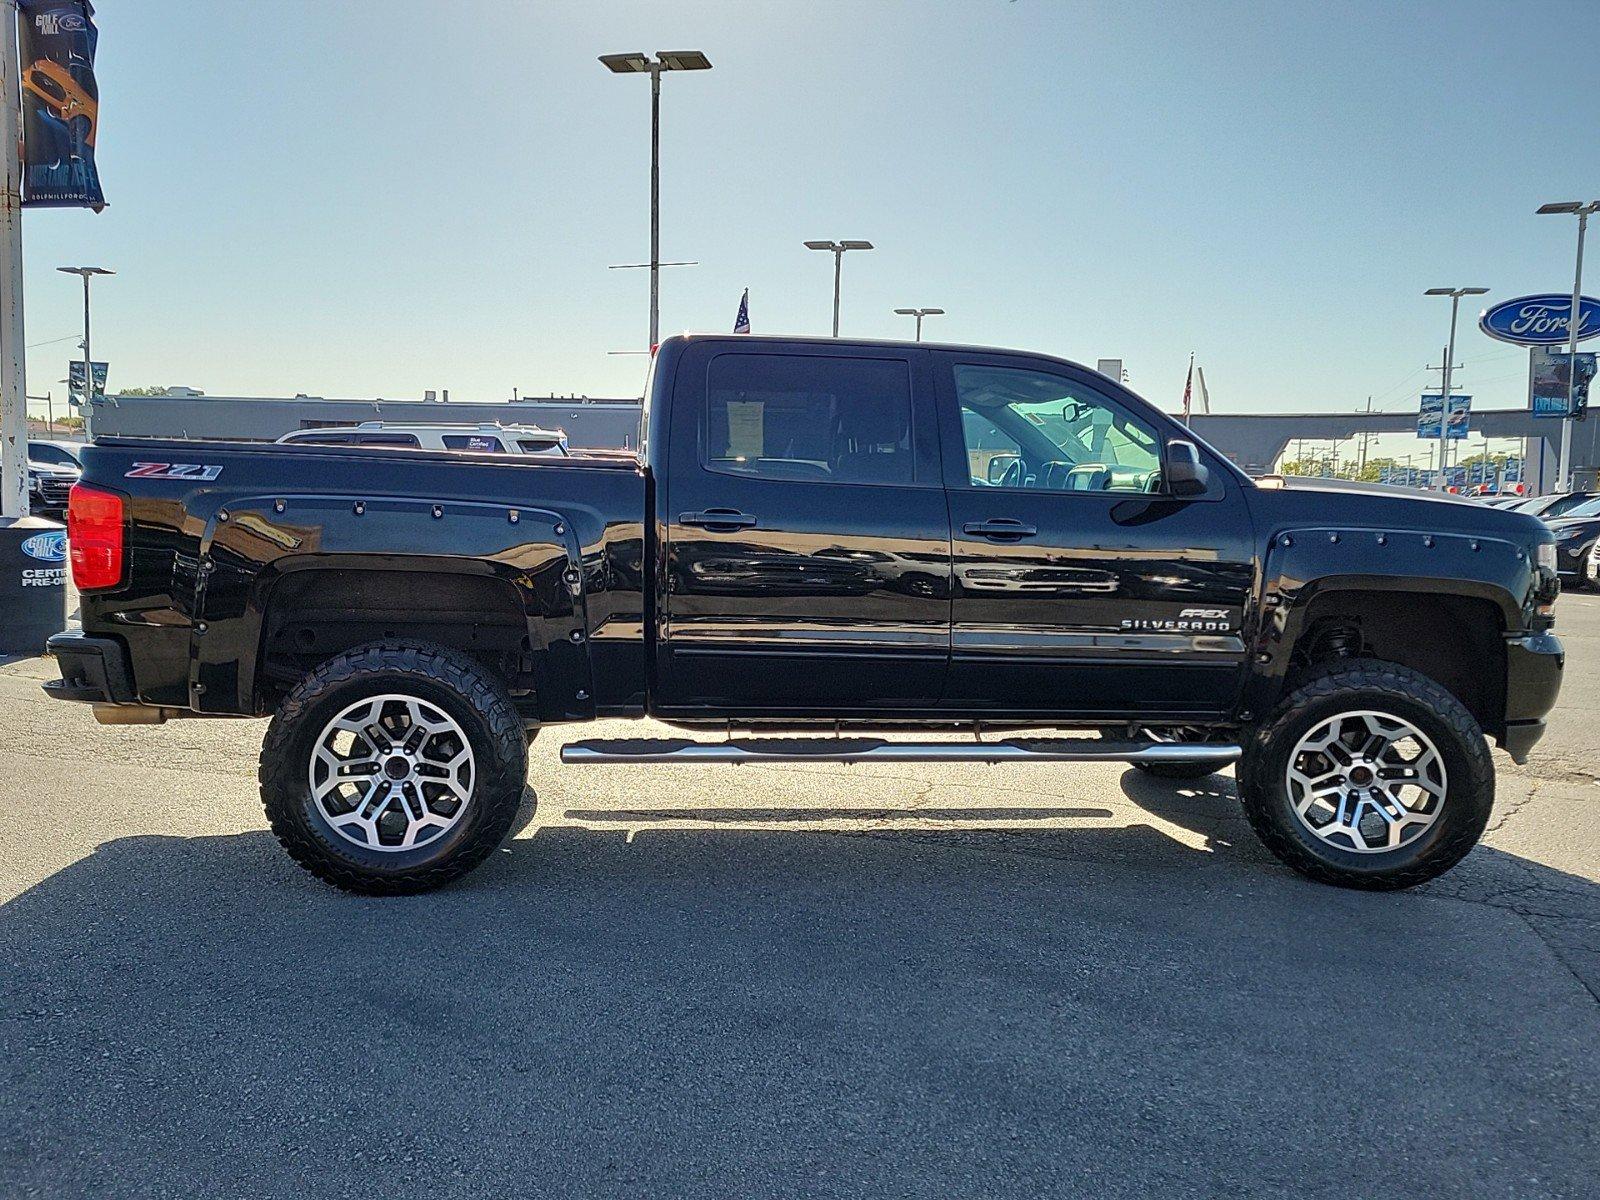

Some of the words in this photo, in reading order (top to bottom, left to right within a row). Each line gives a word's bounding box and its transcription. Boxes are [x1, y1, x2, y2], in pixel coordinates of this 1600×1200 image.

[35, 14, 58, 27] GOLF
[41, 24, 60, 35] MILL
[1510, 304, 1592, 334] Ford
[124, 462, 224, 481] Z71
[28, 536, 54, 549] GOLF
[32, 546, 54, 558] MILL
[1178, 608, 1230, 619] APEX
[1121, 619, 1230, 631] SILVERADO
